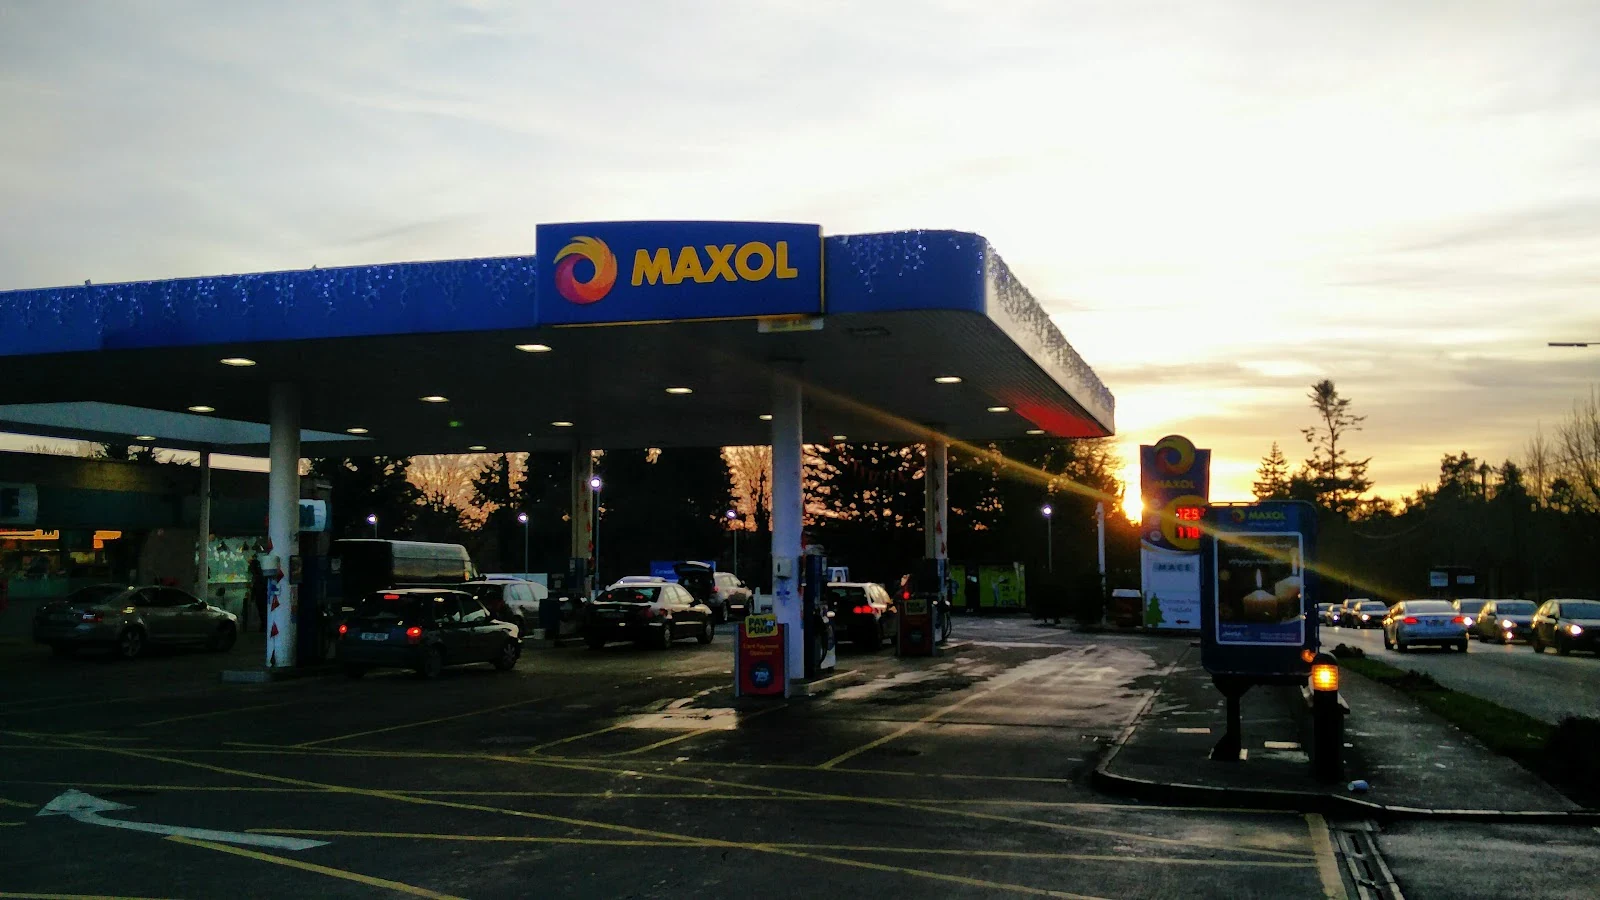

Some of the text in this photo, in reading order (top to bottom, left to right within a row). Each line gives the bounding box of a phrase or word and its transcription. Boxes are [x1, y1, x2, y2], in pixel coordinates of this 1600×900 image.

[631, 241, 798, 286] MAXOL
[1155, 480, 1195, 489] MAXOL
[1247, 511, 1285, 520] MAXOL
[1158, 563, 1191, 572] MACE
[749, 617, 767, 626] PAY
[749, 625, 774, 634] PUMP
